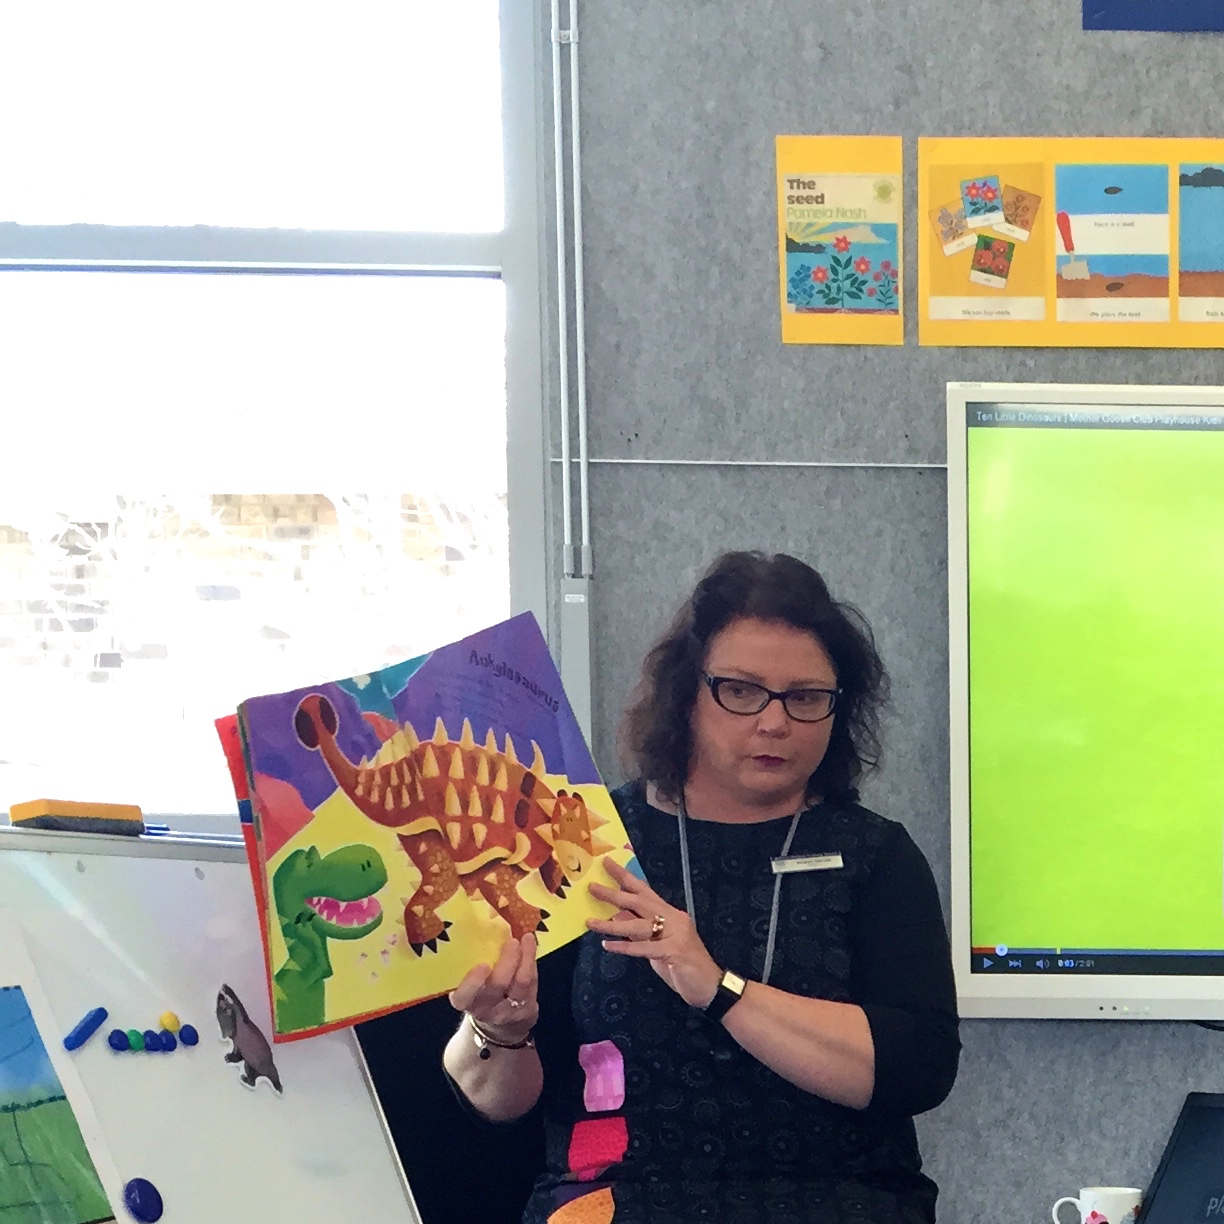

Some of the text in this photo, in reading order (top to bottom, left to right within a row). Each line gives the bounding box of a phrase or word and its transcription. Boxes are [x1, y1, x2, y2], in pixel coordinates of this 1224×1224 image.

[786, 179, 816, 190] The
[786, 193, 825, 205] seed
[836, 207, 867, 219] Nash
[976, 411, 992, 421] Ten
[469, 649, 560, 713] Ankylosaurus
